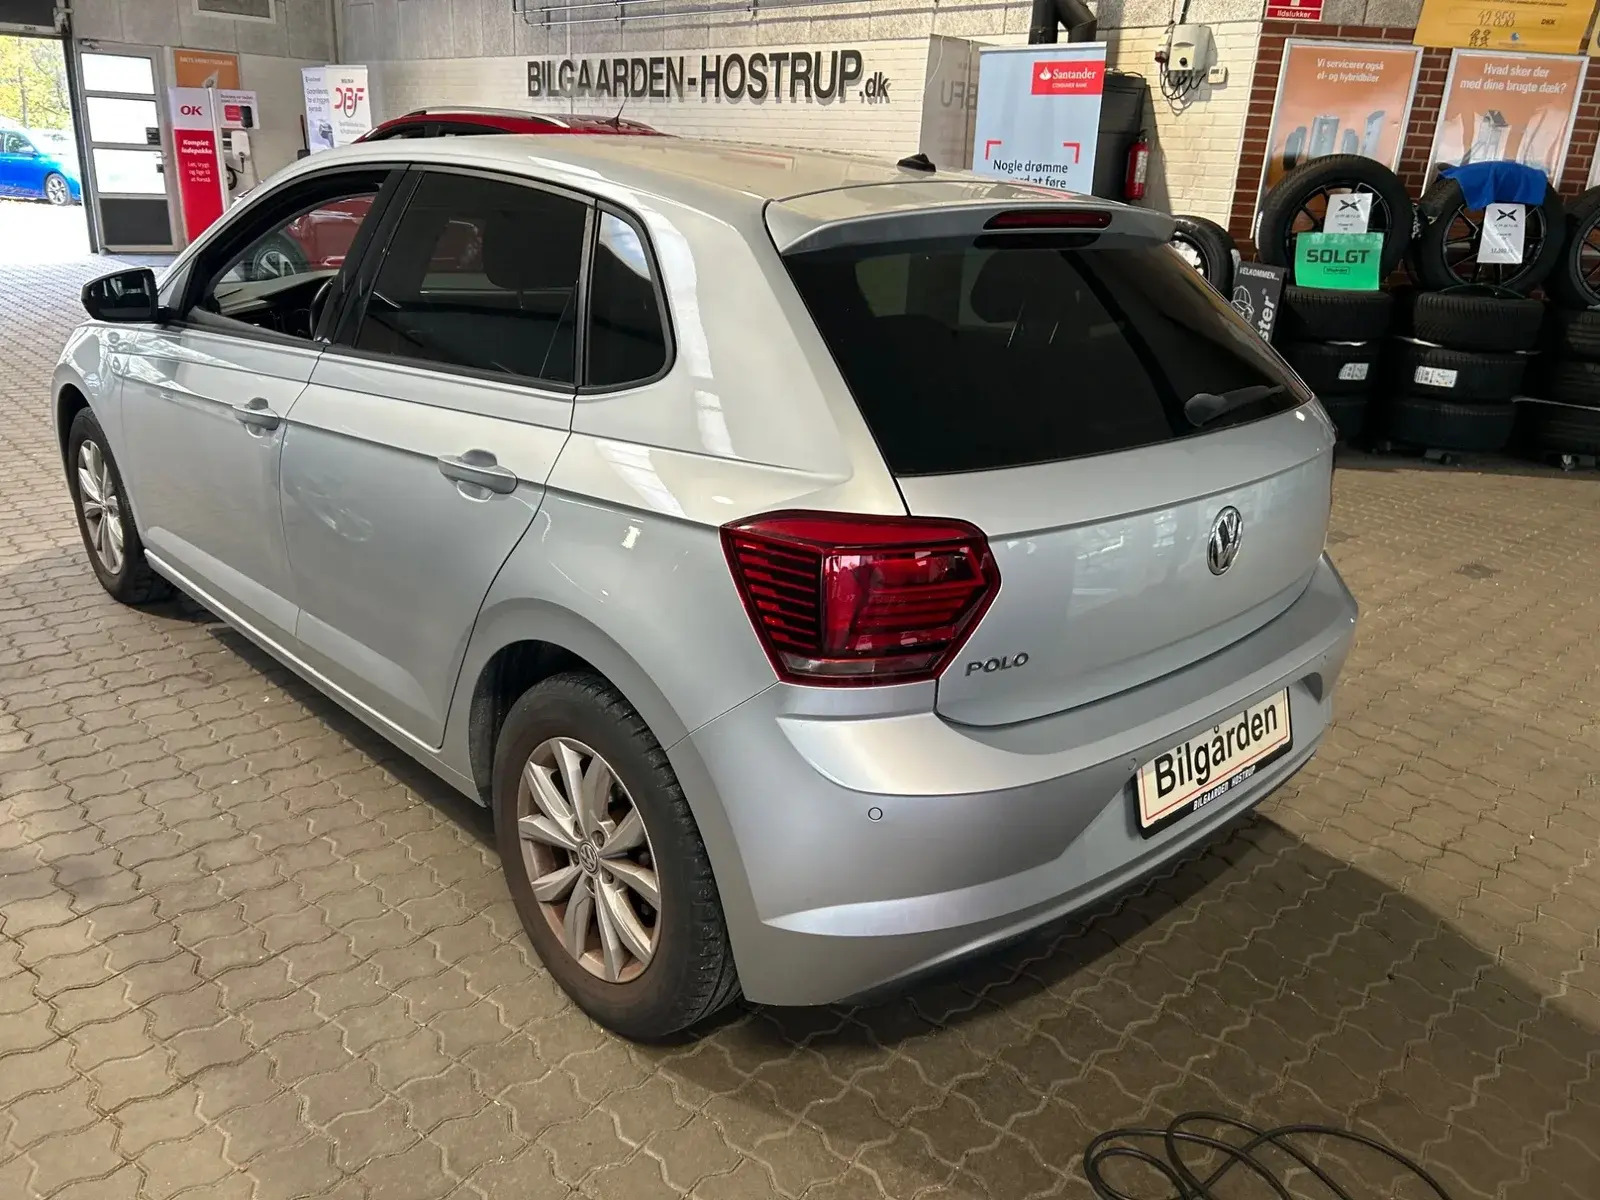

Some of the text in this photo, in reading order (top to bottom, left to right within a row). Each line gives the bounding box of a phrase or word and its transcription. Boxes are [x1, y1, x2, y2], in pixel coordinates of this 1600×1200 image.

[1277, 9, 1311, 18] Ildslukker
[1541, 18, 1556, 26] DKK
[1317, 58, 1384, 71] Vi servicerer også
[1484, 63, 1550, 78] Hvad sker der
[1053, 67, 1097, 80] Santander
[1329, 73, 1338, 82] og
[1339, 72, 1379, 83] hybridbiler
[1460, 78, 1567, 95] med dine brugte dæk?
[180, 105, 203, 116] OK
[993, 159, 1068, 175] Nogle drømme
[1045, 176, 1067, 188] føre
[1306, 249, 1371, 264] SOLGT
[964, 652, 1029, 677] POLO
[1154, 704, 1278, 799] Bilgården
[1193, 765, 1256, 811] BILGAARDEN HOSTRUP
